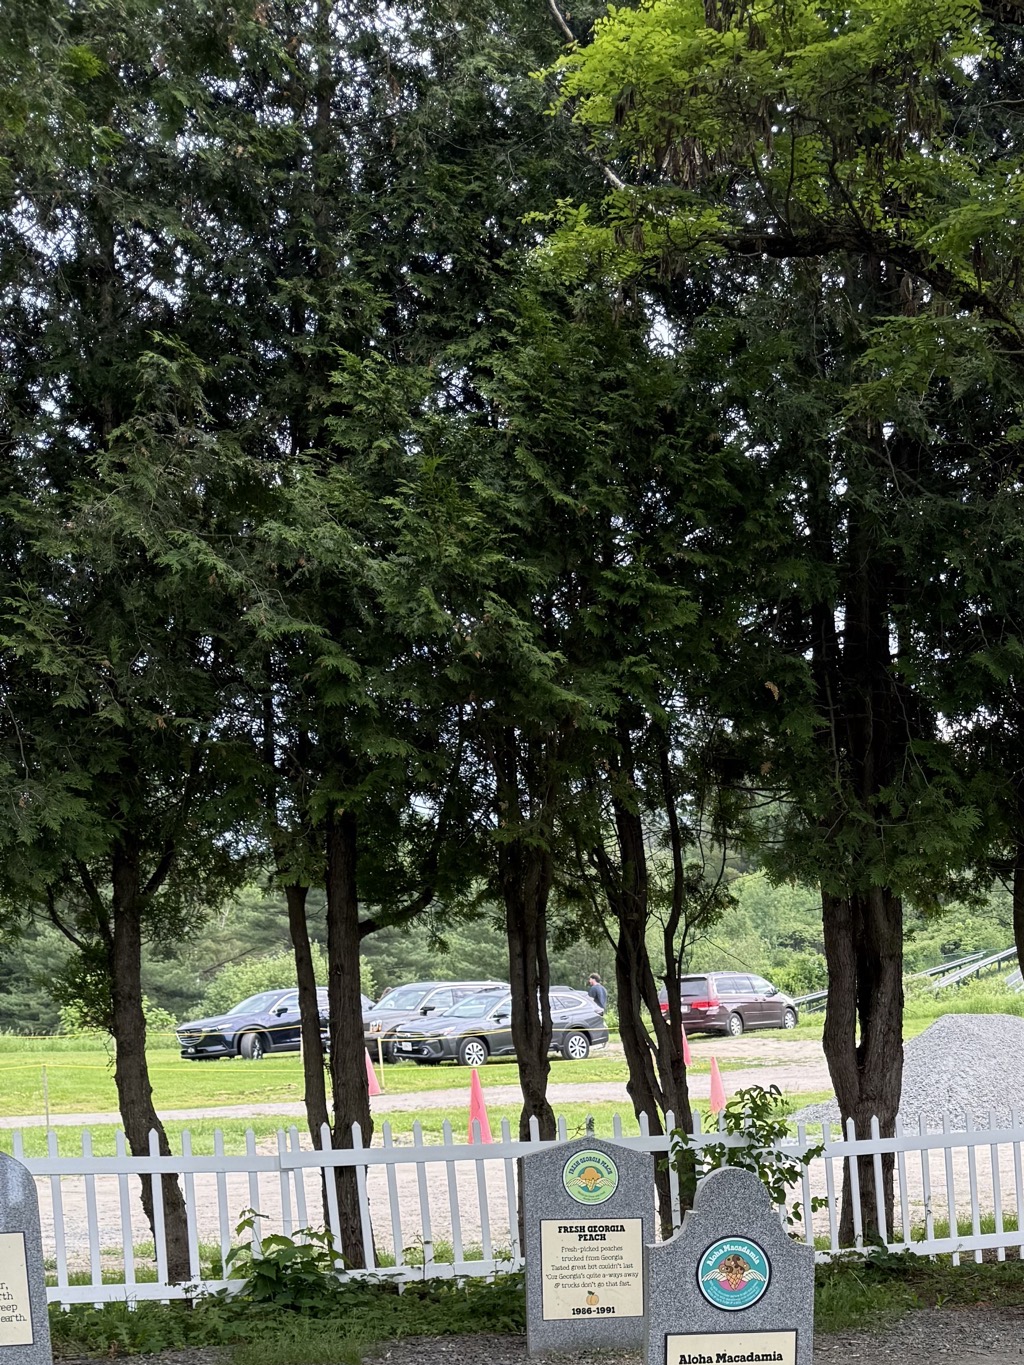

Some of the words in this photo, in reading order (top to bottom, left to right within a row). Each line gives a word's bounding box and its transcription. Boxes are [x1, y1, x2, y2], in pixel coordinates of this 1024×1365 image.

[707, 1249, 724, 1266] Aloha
[723, 1244, 760, 1265] Macadamia
[0, 1304, 17, 1312] eep
[572, 1307, 615, 1315] 1986-1991
[679, 1354, 713, 1365] Aloha
[716, 1351, 783, 1363] Macadamia
